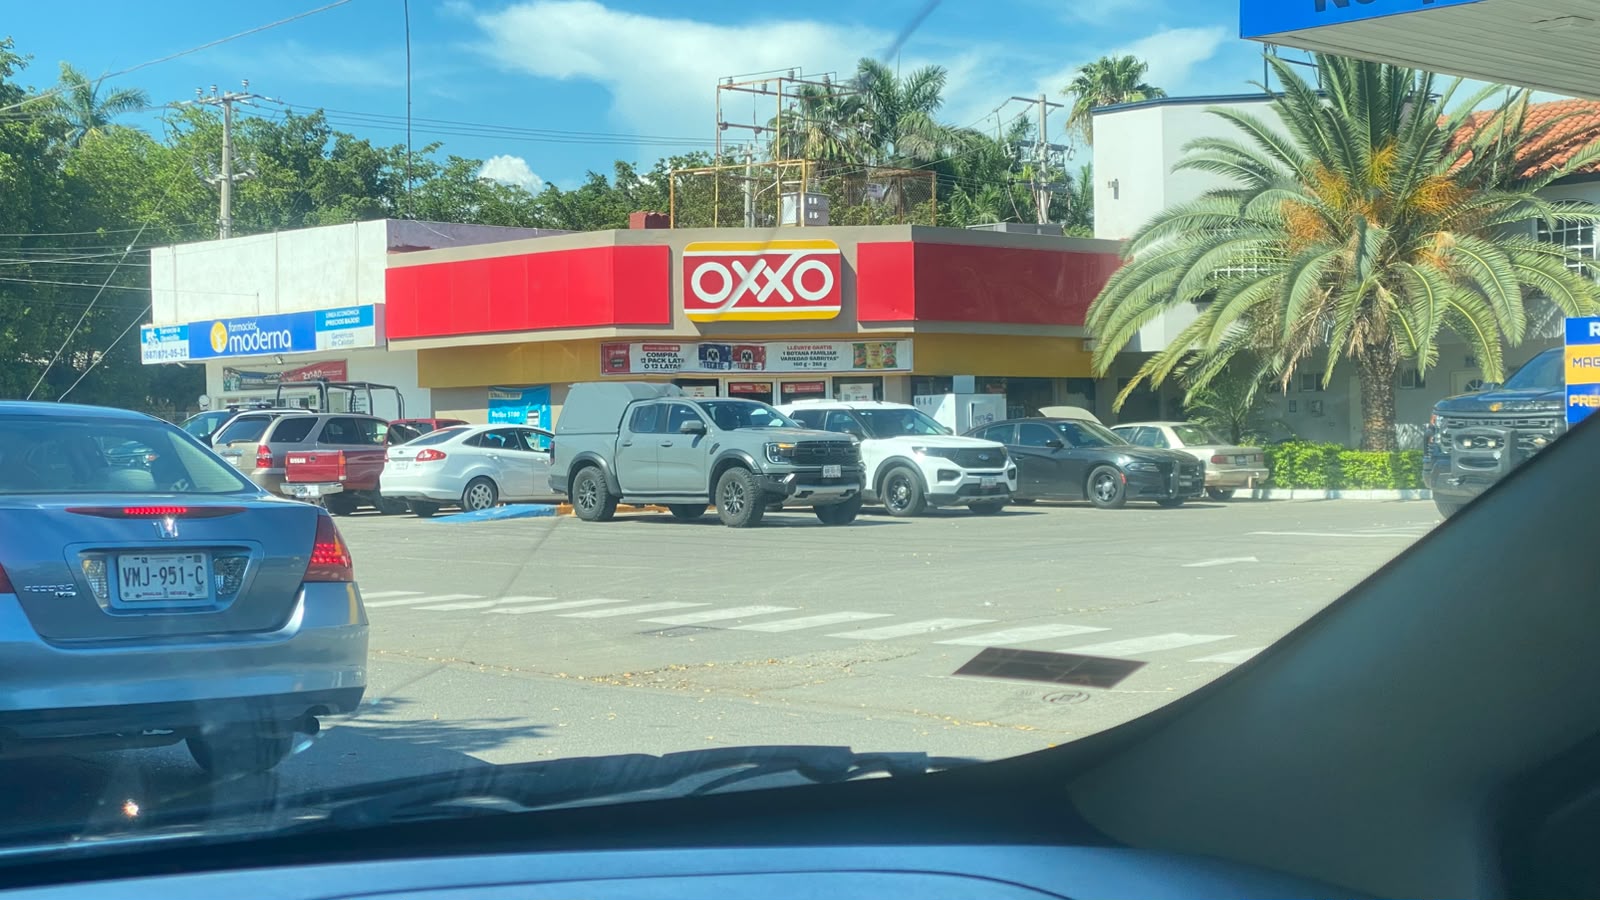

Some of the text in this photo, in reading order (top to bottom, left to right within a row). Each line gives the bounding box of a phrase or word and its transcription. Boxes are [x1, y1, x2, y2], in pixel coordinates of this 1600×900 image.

[690, 257, 834, 306] OXXO
[228, 321, 257, 333] farmacias
[229, 328, 292, 353] moderna
[122, 565, 204, 588] VMJ-951-C
